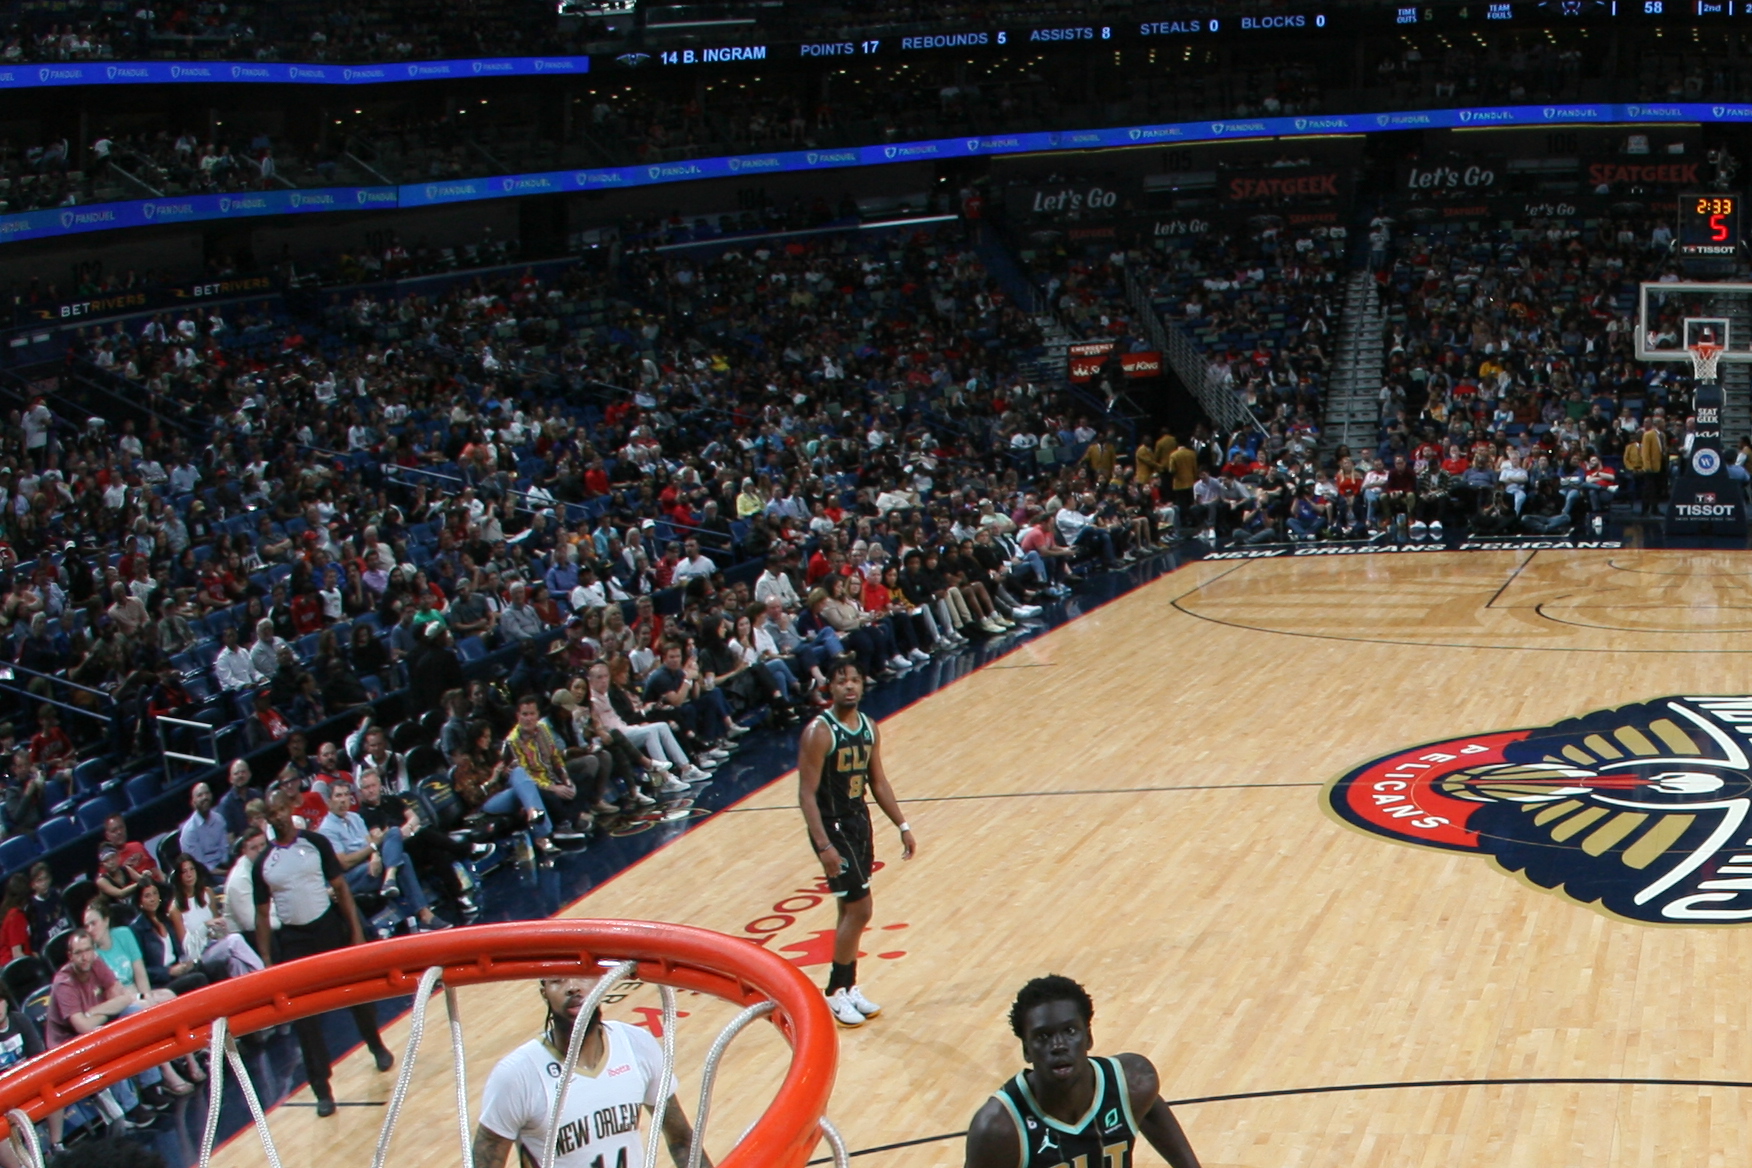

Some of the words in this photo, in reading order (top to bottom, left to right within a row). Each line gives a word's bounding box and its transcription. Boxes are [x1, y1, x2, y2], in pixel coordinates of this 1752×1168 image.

[1644, 1, 1663, 14] 58
[1703, 4, 1722, 12] 2nd
[660, 51, 678, 65] 14
[683, 50, 698, 64] B.
[703, 46, 766, 62] INGRAM
[801, 42, 854, 56] POINTS
[861, 41, 879, 54] 17
[902, 32, 988, 50] REBOUNDS
[997, 31, 1006, 44] 5
[1030, 27, 1094, 42] ASSISTS
[1101, 26, 1111, 40] 8
[1140, 20, 1200, 35] STEALS
[1209, 19, 1218, 33] 0
[1241, 15, 1305, 29] BLOCKS
[1316, 14, 1326, 28] 0
[1557, 108, 1598, 118] FANDUEL
[1640, 108, 1682, 117] FANDUEL
[1408, 166, 1457, 189] Let's
[1464, 165, 1494, 187] Go
[1588, 162, 1701, 185] SEATGEEK
[1229, 174, 1339, 200] SEATGEEK
[1033, 189, 1084, 213] Let's
[1086, 187, 1117, 210] Go
[1697, 198, 1733, 215] 2:33
[75, 210, 116, 224] FANDUEL
[1556, 202, 1576, 217] Go
[1154, 220, 1187, 236] Let's
[1708, 214, 1730, 242] 5
[1696, 246, 1735, 254] TISSOT
[194, 276, 270, 298] BETRIVERS
[61, 293, 146, 318] BETRIVERS
[1697, 407, 1718, 416] SEAT
[1675, 504, 1735, 516] TISSOT
[1203, 548, 1287, 560] NEW
[1295, 543, 1447, 556] ORLEANS
[1459, 541, 1623, 551] PELICANS
[1372, 743, 1489, 831] PELICANS
[556, 1115, 591, 1158] NEW
[594, 1102, 640, 1140] ORLEA
[1025, 1116, 1038, 1130] 6
